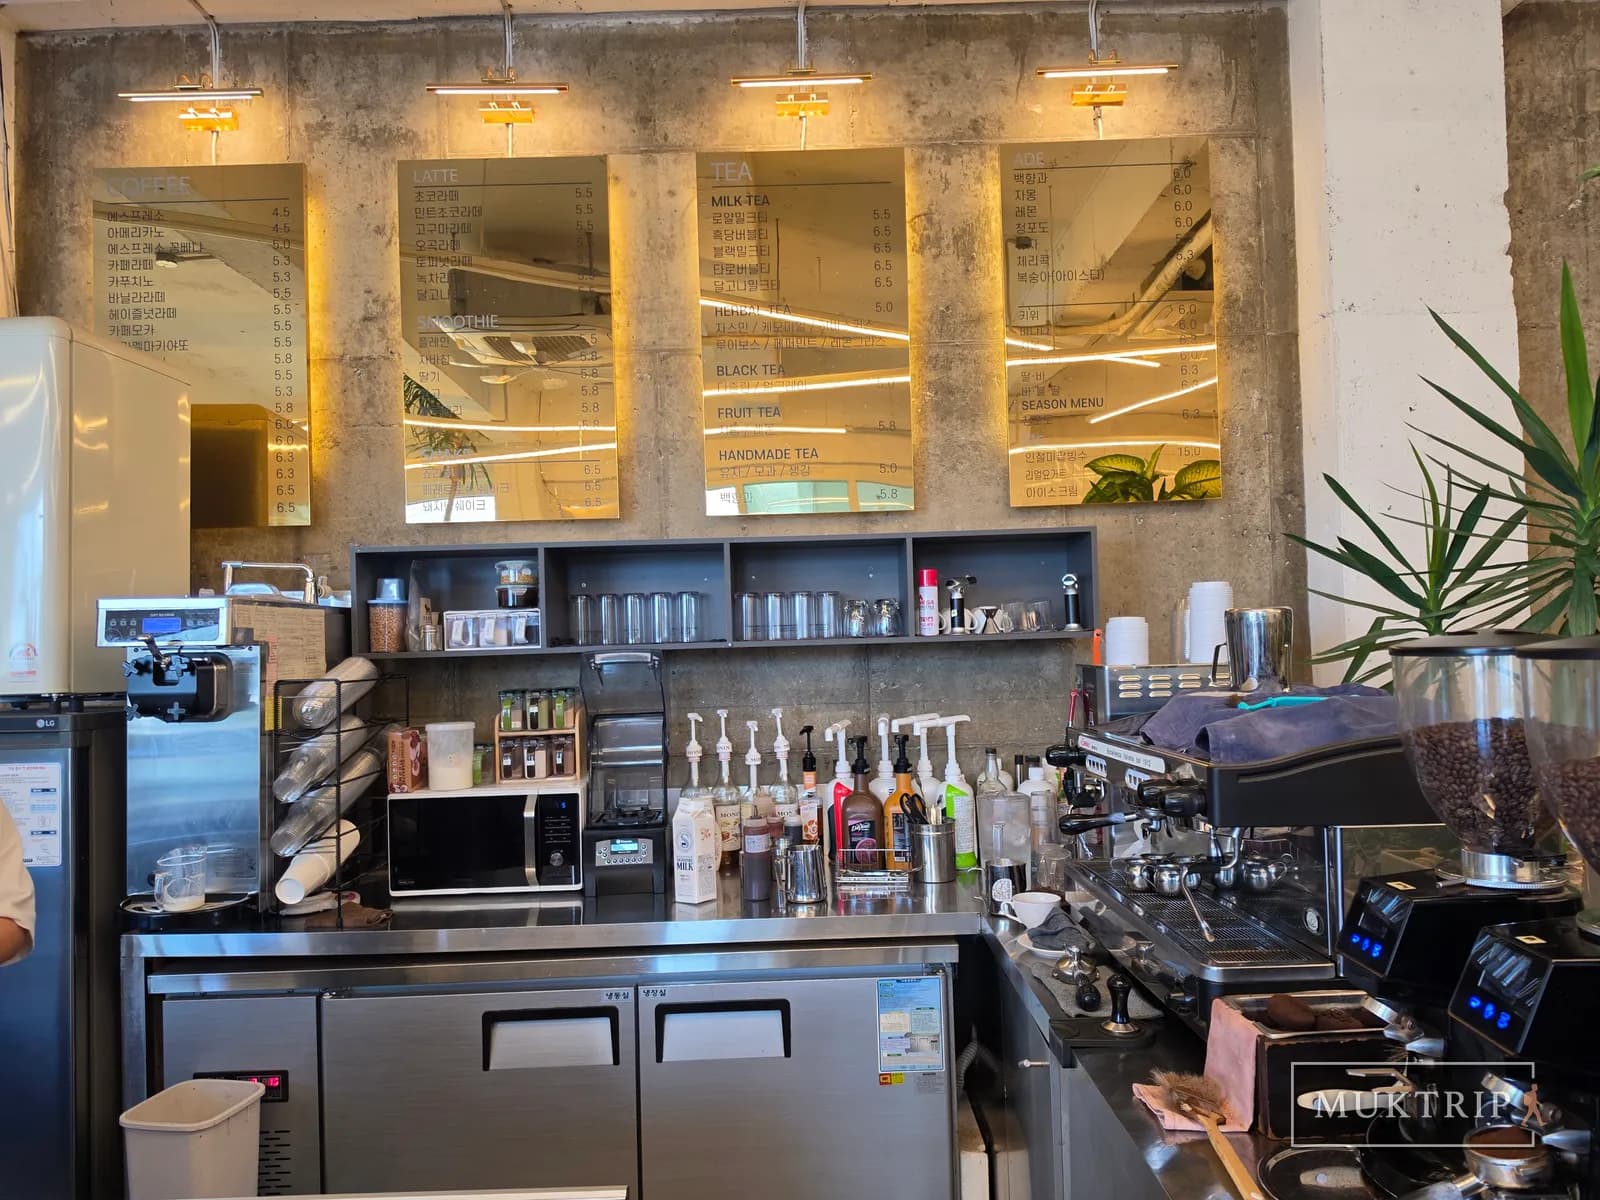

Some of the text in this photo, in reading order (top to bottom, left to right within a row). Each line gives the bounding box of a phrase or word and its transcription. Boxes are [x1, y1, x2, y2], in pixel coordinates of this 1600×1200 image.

[1014, 152, 1046, 166] ADE
[413, 168, 459, 184] LATTE
[711, 160, 753, 181] TEA
[1173, 168, 1191, 179] 6.0
[1014, 172, 1048, 185] 백향과
[107, 176, 193, 198] COFFEE
[1173, 184, 1192, 195] 6.0
[575, 188, 593, 198] 5.5
[1015, 189, 1037, 201] 자몽
[711, 194, 770, 208] MILK TEA
[1174, 201, 1193, 211] 6.0
[272, 207, 290, 218] 4.5
[575, 204, 594, 215] 5.5
[873, 209, 891, 220] 5.5
[1015, 205, 1037, 218] 레몬
[576, 221, 594, 232] 5.5
[1175, 217, 1193, 228] 6.0
[107, 226, 165, 238] 아메리카노
[272, 223, 290, 234] 4.5
[873, 226, 891, 237] 6.5
[107, 242, 164, 255] 에스프레소
[272, 239, 291, 250] 5.0
[873, 242, 892, 253] 6.5
[107, 259, 154, 271] 카페라떼
[272, 255, 291, 266] 5.3
[874, 260, 892, 271] 6.5
[108, 275, 154, 287] 카푸치노
[273, 272, 291, 282] 5.3
[874, 277, 893, 288] 6.5
[108, 291, 166, 304] 바닐라라떼
[273, 288, 291, 299] 5.5
[273, 304, 292, 315] 5.5
[767, 304, 792, 315] TEA
[875, 302, 893, 313] 5.0
[1178, 303, 1197, 314] 6.0
[108, 307, 177, 320] 헤이즐넛라떼
[1018, 309, 1040, 321] 키위
[273, 320, 292, 331] 5.5
[417, 314, 500, 329] SMOOTHIE
[1179, 319, 1197, 330] 6.0
[108, 324, 155, 336] 카페모카
[274, 337, 292, 348] 5.5
[274, 354, 293, 364] 5.8
[274, 370, 293, 380] 5.5
[580, 368, 598, 379] 5.8
[716, 364, 786, 377] BLACK TEA
[1180, 364, 1199, 375] 6.3
[419, 371, 441, 383] 딸기
[275, 386, 293, 397] 5.3
[581, 385, 599, 396] 5.8
[275, 403, 294, 413] 5.8
[582, 402, 600, 413] 5.8
[1022, 397, 1104, 411] SEASON MENU
[717, 406, 781, 419] FRUIT TEA
[275, 419, 294, 430] 6.0
[878, 420, 896, 431] 5.8
[275, 435, 294, 446] 6.0
[276, 452, 295, 463] 6.3
[718, 448, 819, 461] HANDMADE TEA
[276, 469, 295, 479] 6.3
[584, 465, 600, 475] 6.5
[879, 463, 898, 474] 5.0
[276, 485, 296, 496] 6.5
[585, 481, 601, 491] 6.5
[880, 488, 898, 499] 5.8
[1026, 486, 1078, 498] 아이스크림
[277, 502, 296, 513] 6.5
[45, 719, 55, 727] LG
[676, 862, 694, 871] MILK
